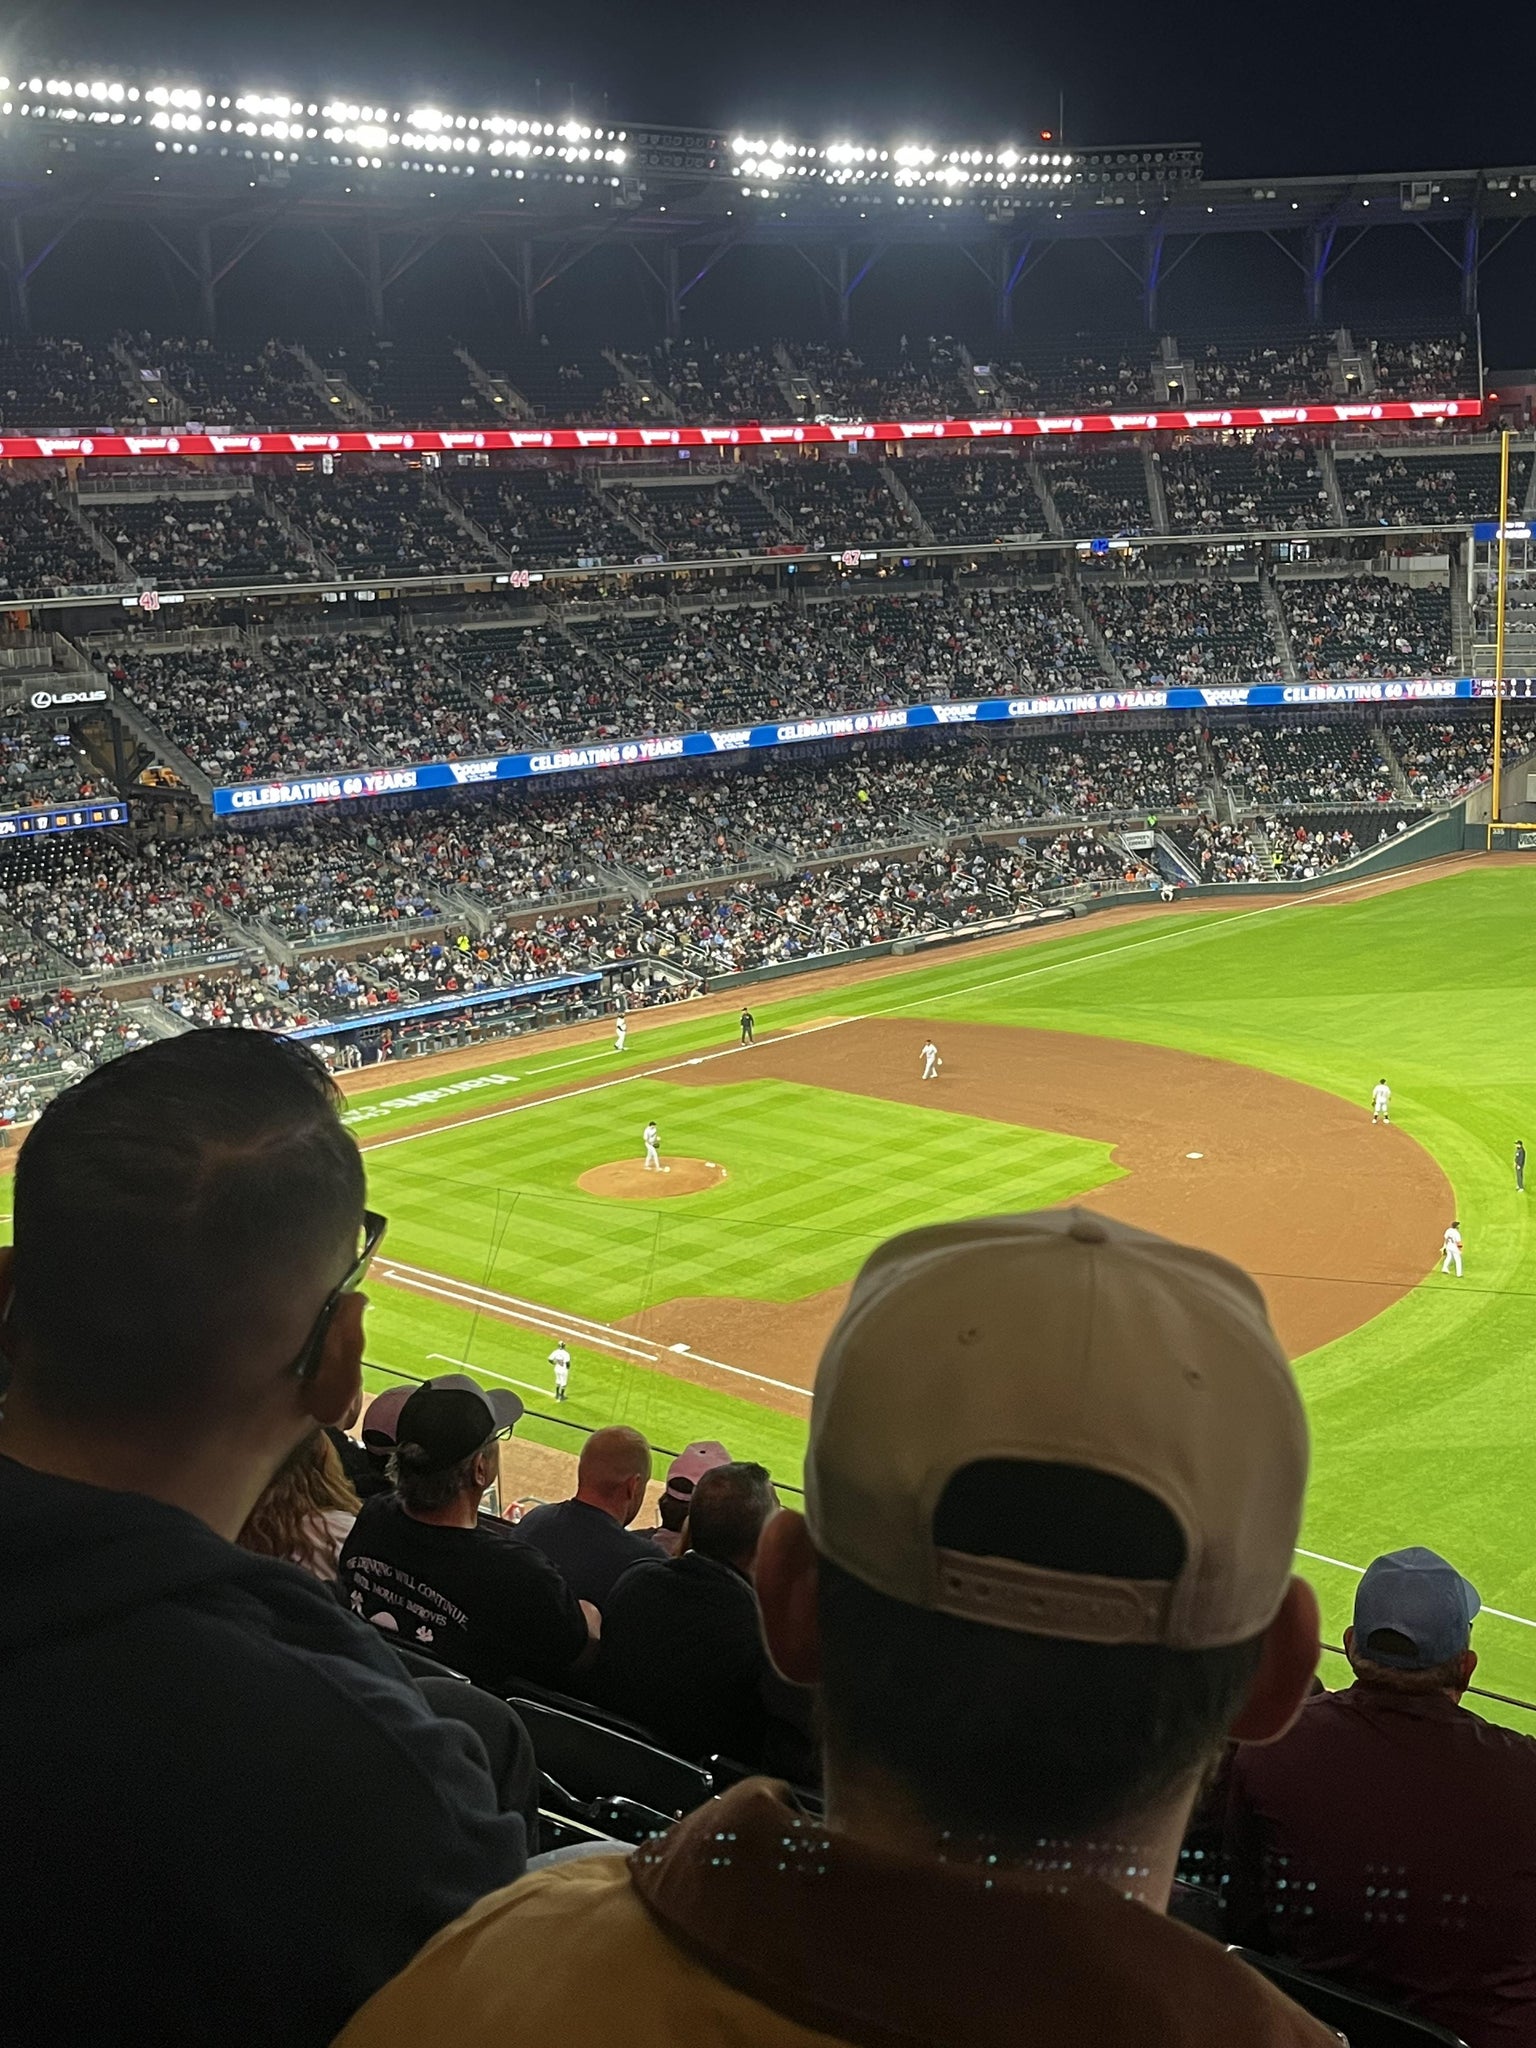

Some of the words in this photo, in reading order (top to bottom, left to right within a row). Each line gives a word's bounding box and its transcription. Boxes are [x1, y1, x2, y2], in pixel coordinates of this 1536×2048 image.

[842, 550, 861, 566] 47
[510, 570, 530, 588] 44
[139, 591, 160, 611] 41
[52, 690, 107, 704] LEXUS
[1008, 695, 1097, 716] CELEBRATING
[1100, 694, 1115, 709] 60
[1118, 691, 1167, 708] YEARS!
[1283, 684, 1382, 702] CELEBRATING
[1385, 683, 1401, 698] 60
[1405, 681, 1457, 697] YEARS!
[777, 718, 854, 741] CELEBRATING
[855, 716, 869, 732] 60
[870, 711, 907, 728] YEARS!
[530, 745, 619, 772] CELEBRATING
[622, 744, 638, 761] 60
[640, 738, 683, 758] YEARS!
[232, 779, 341, 808] CELEBRATING
[343, 777, 363, 795] 60
[365, 770, 417, 792] YEARS!
[372, 1581, 405, 1606] MORALE
[405, 1599, 448, 1627] IMPROVES
[394, 1568, 416, 1590] WILL
[417, 1582, 469, 1625] CONTINUE
